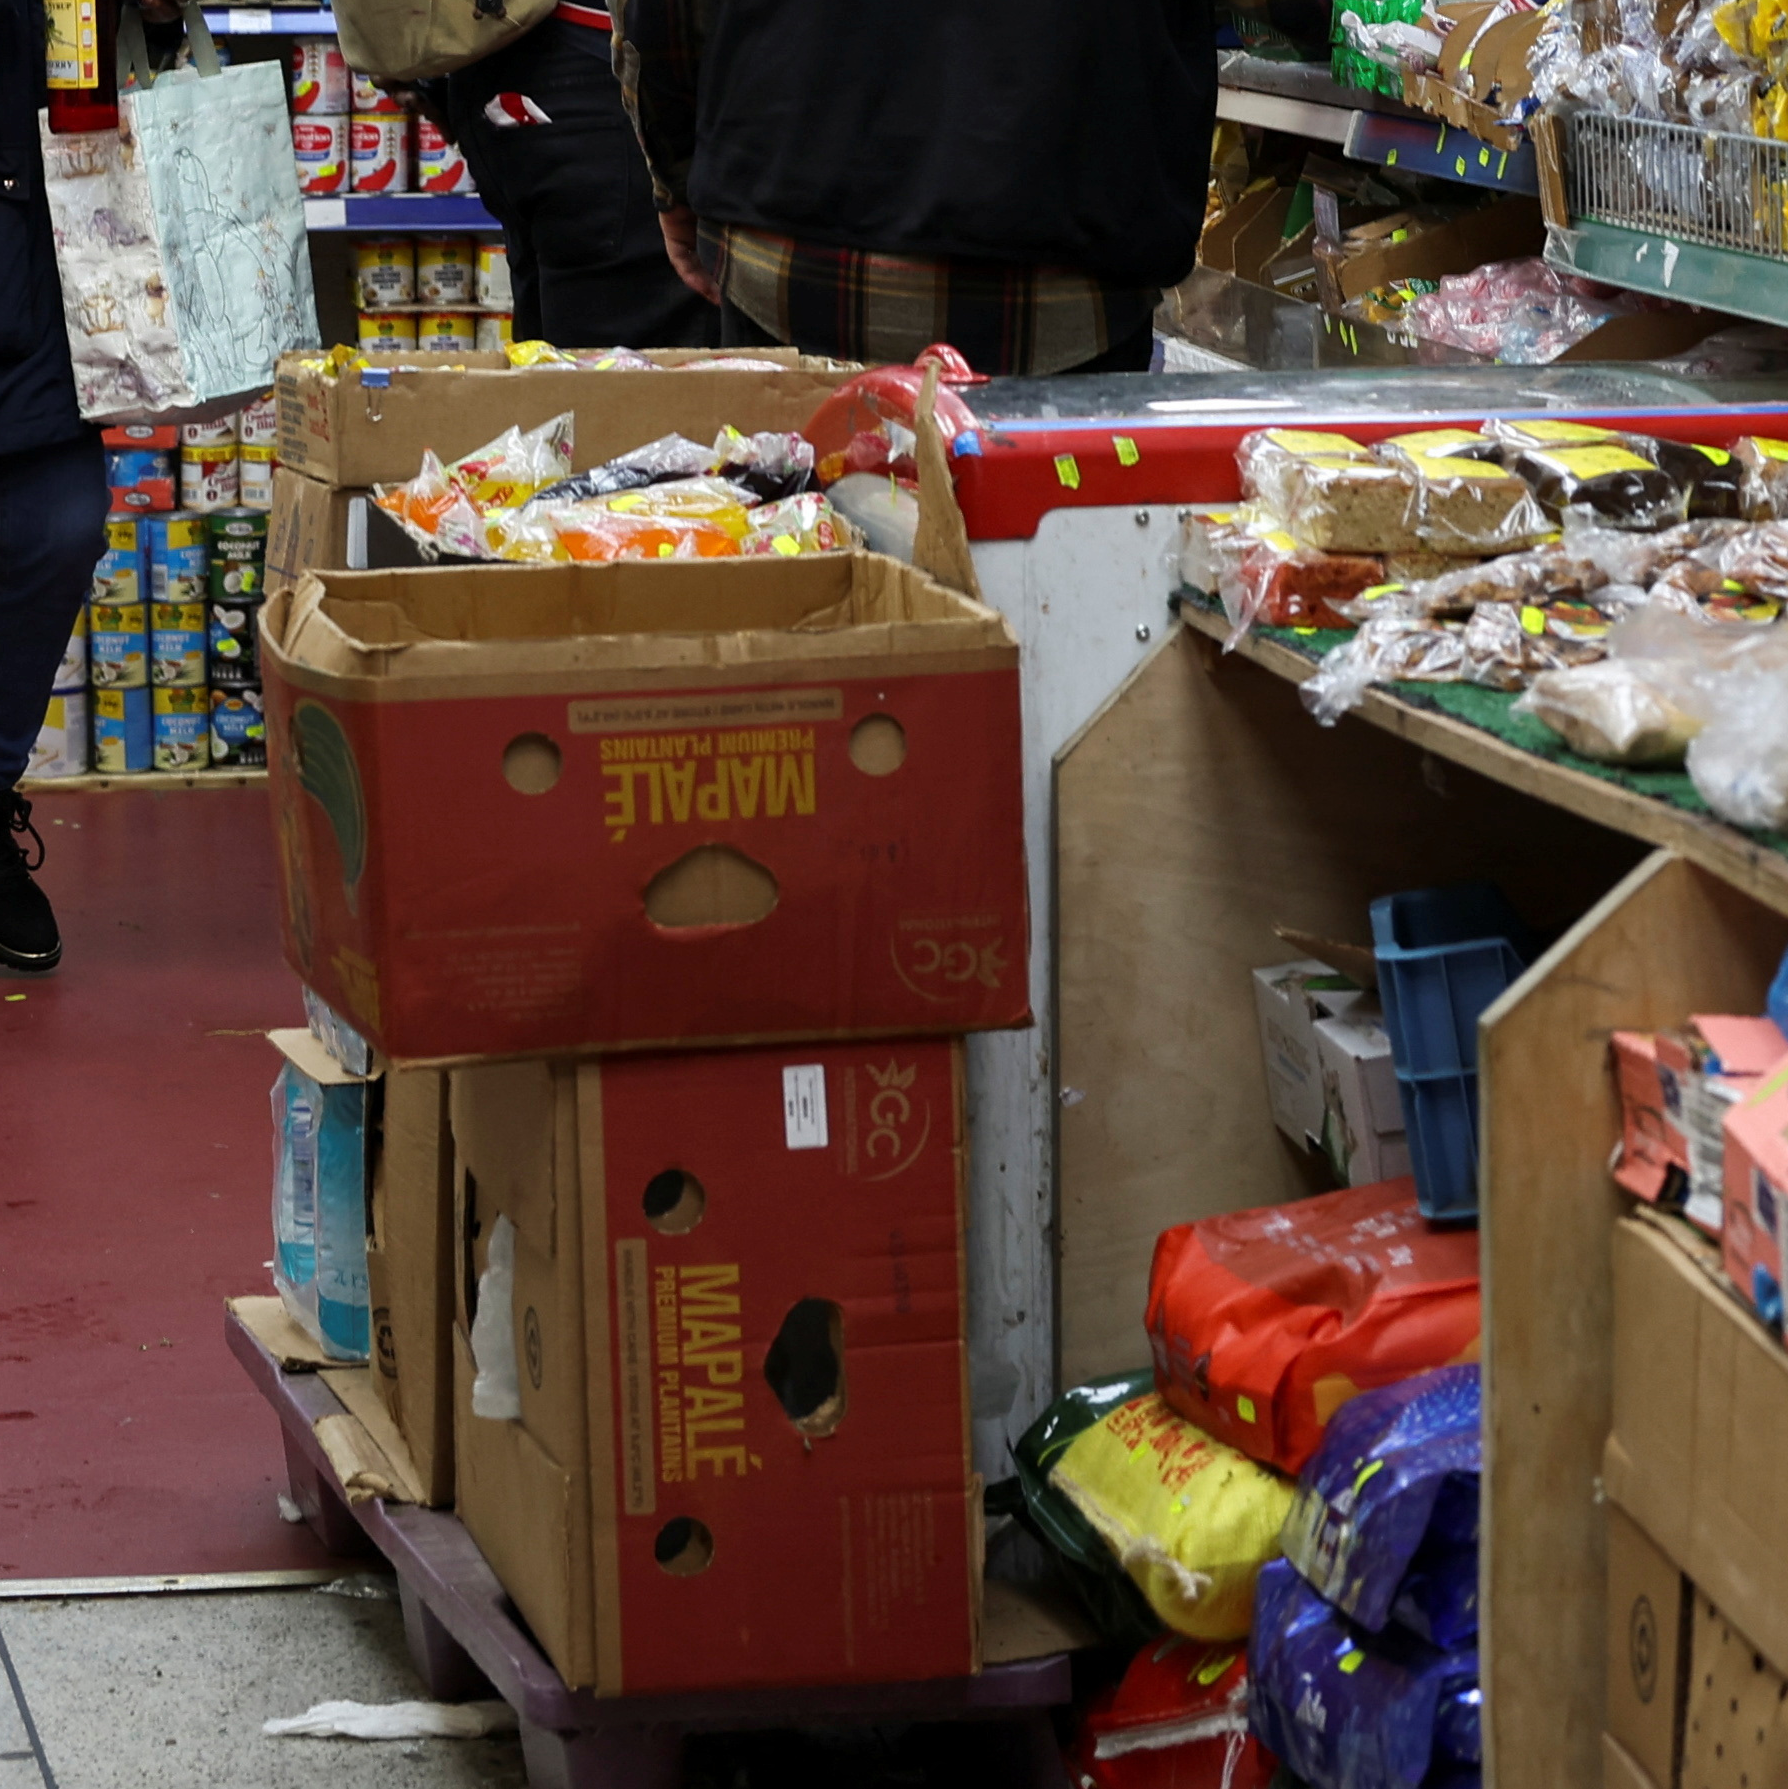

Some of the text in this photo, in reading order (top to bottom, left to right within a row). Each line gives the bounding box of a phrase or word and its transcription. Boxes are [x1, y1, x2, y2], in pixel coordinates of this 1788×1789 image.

[599, 727, 816, 761] PREMIUM PLANTAINS
[601, 752, 817, 842] MAPALÉ
[654, 1264, 683, 1483] PREMIUM PLANTAINS
[679, 1263, 762, 1481] MAPALÉ
